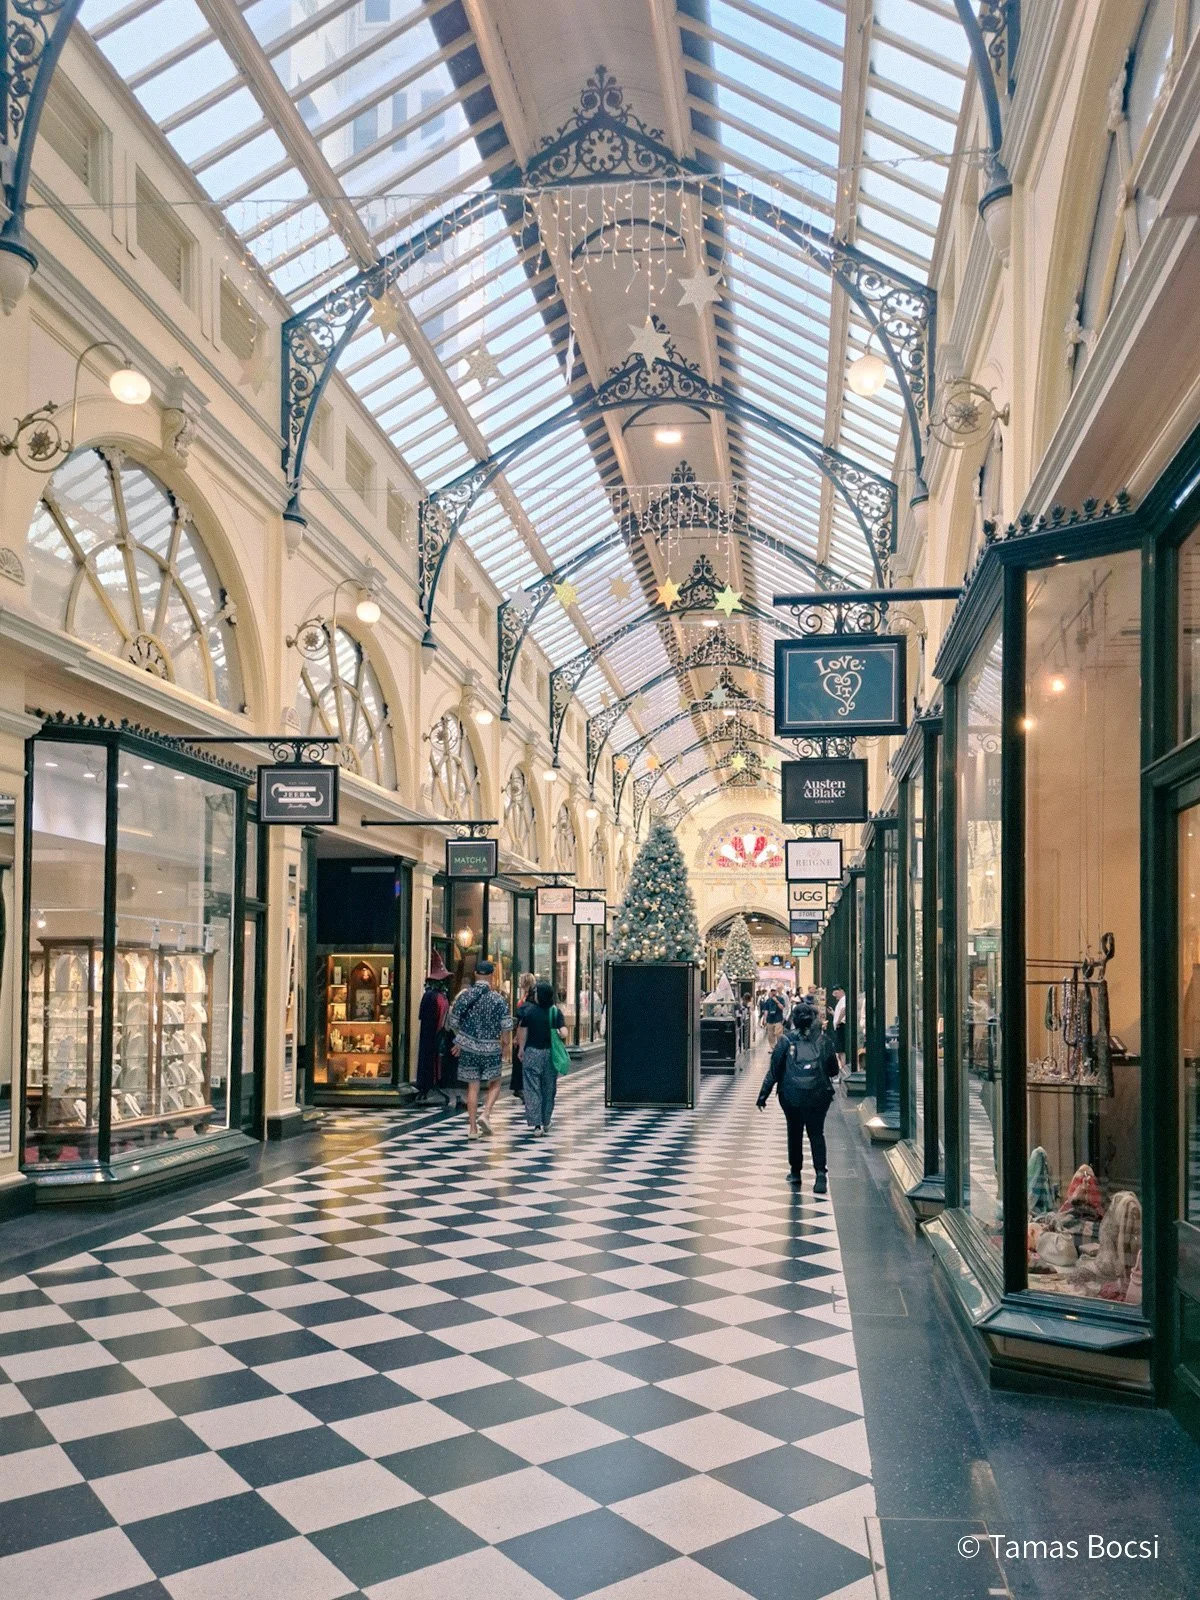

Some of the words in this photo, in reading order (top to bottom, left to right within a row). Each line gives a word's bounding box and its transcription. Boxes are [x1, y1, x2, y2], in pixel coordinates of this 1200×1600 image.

[802, 778, 846, 789] Austen
[803, 788, 846, 798] &Blake
[454, 856, 488, 864] MATCHA
[795, 859, 833, 867] REIGNE
[793, 891, 823, 902] UGG
